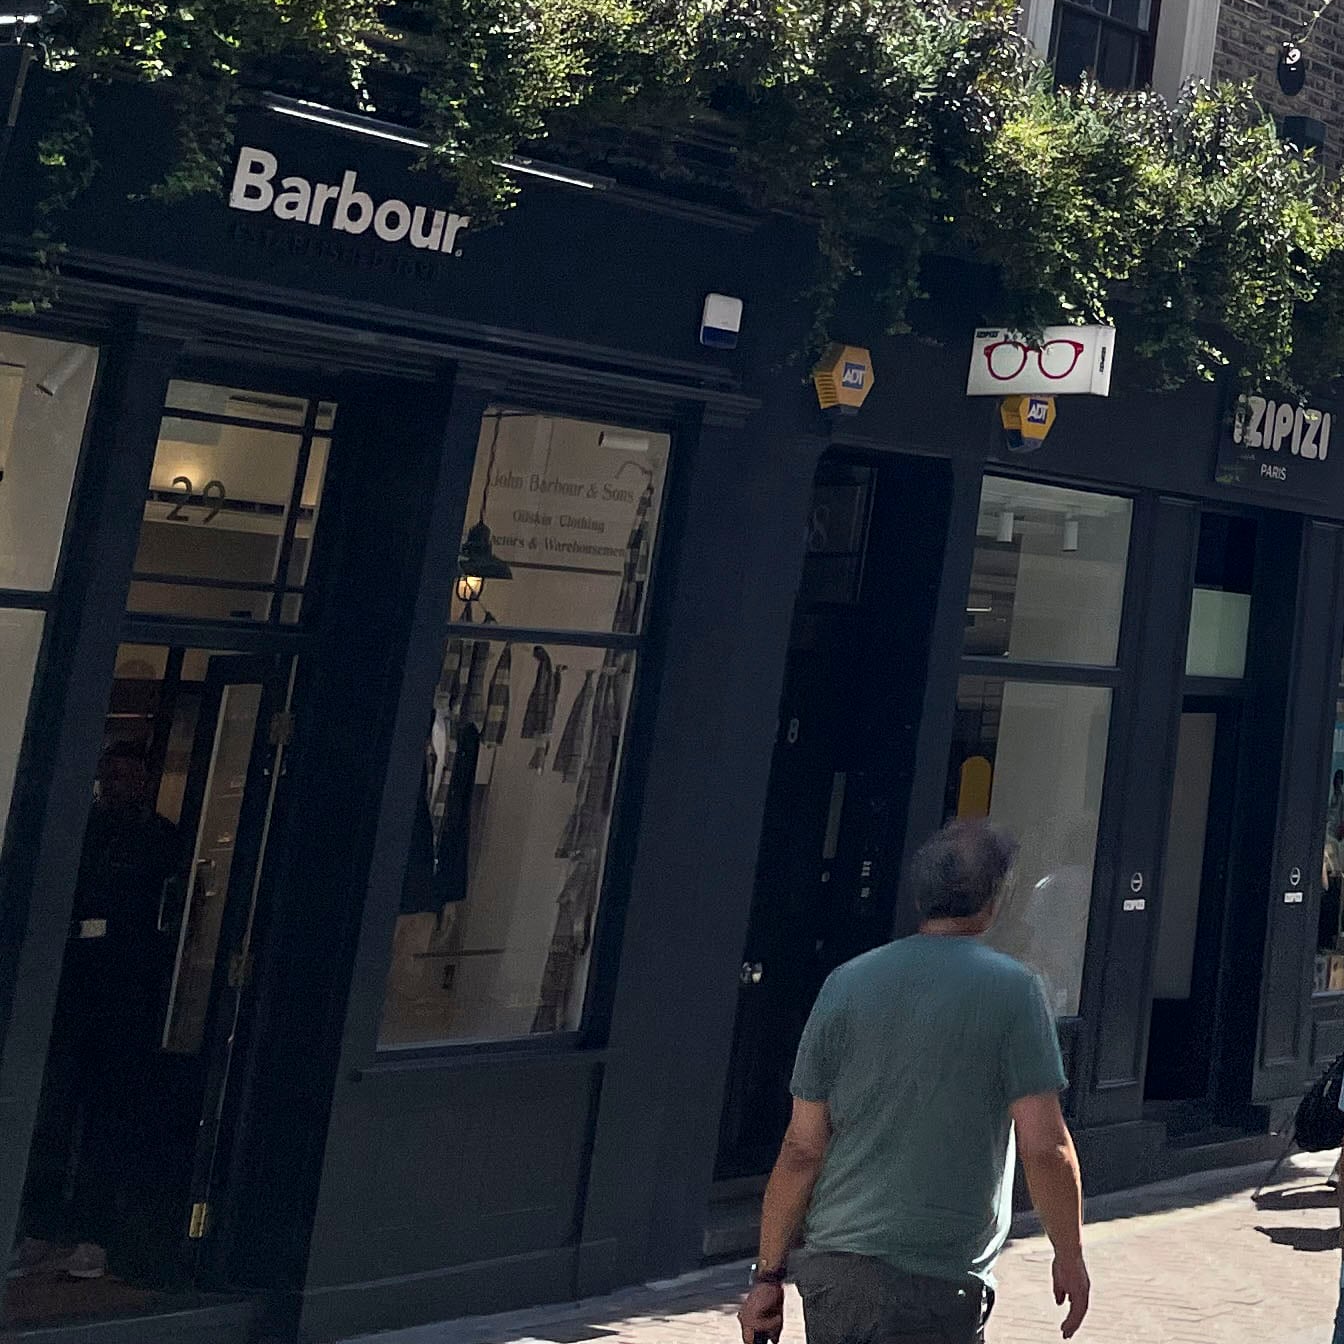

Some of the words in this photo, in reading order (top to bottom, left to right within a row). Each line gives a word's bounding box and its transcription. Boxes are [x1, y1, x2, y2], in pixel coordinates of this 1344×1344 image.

[229, 146, 471, 254] Barbour
[842, 367, 866, 386] ADT
[1027, 402, 1048, 421] ADT
[1261, 463, 1287, 480] PARIS
[491, 469, 523, 489] John
[530, 474, 583, 497] Barbour
[586, 485, 599, 498] &
[601, 483, 634, 504] Sons
[167, 476, 226, 525] 29
